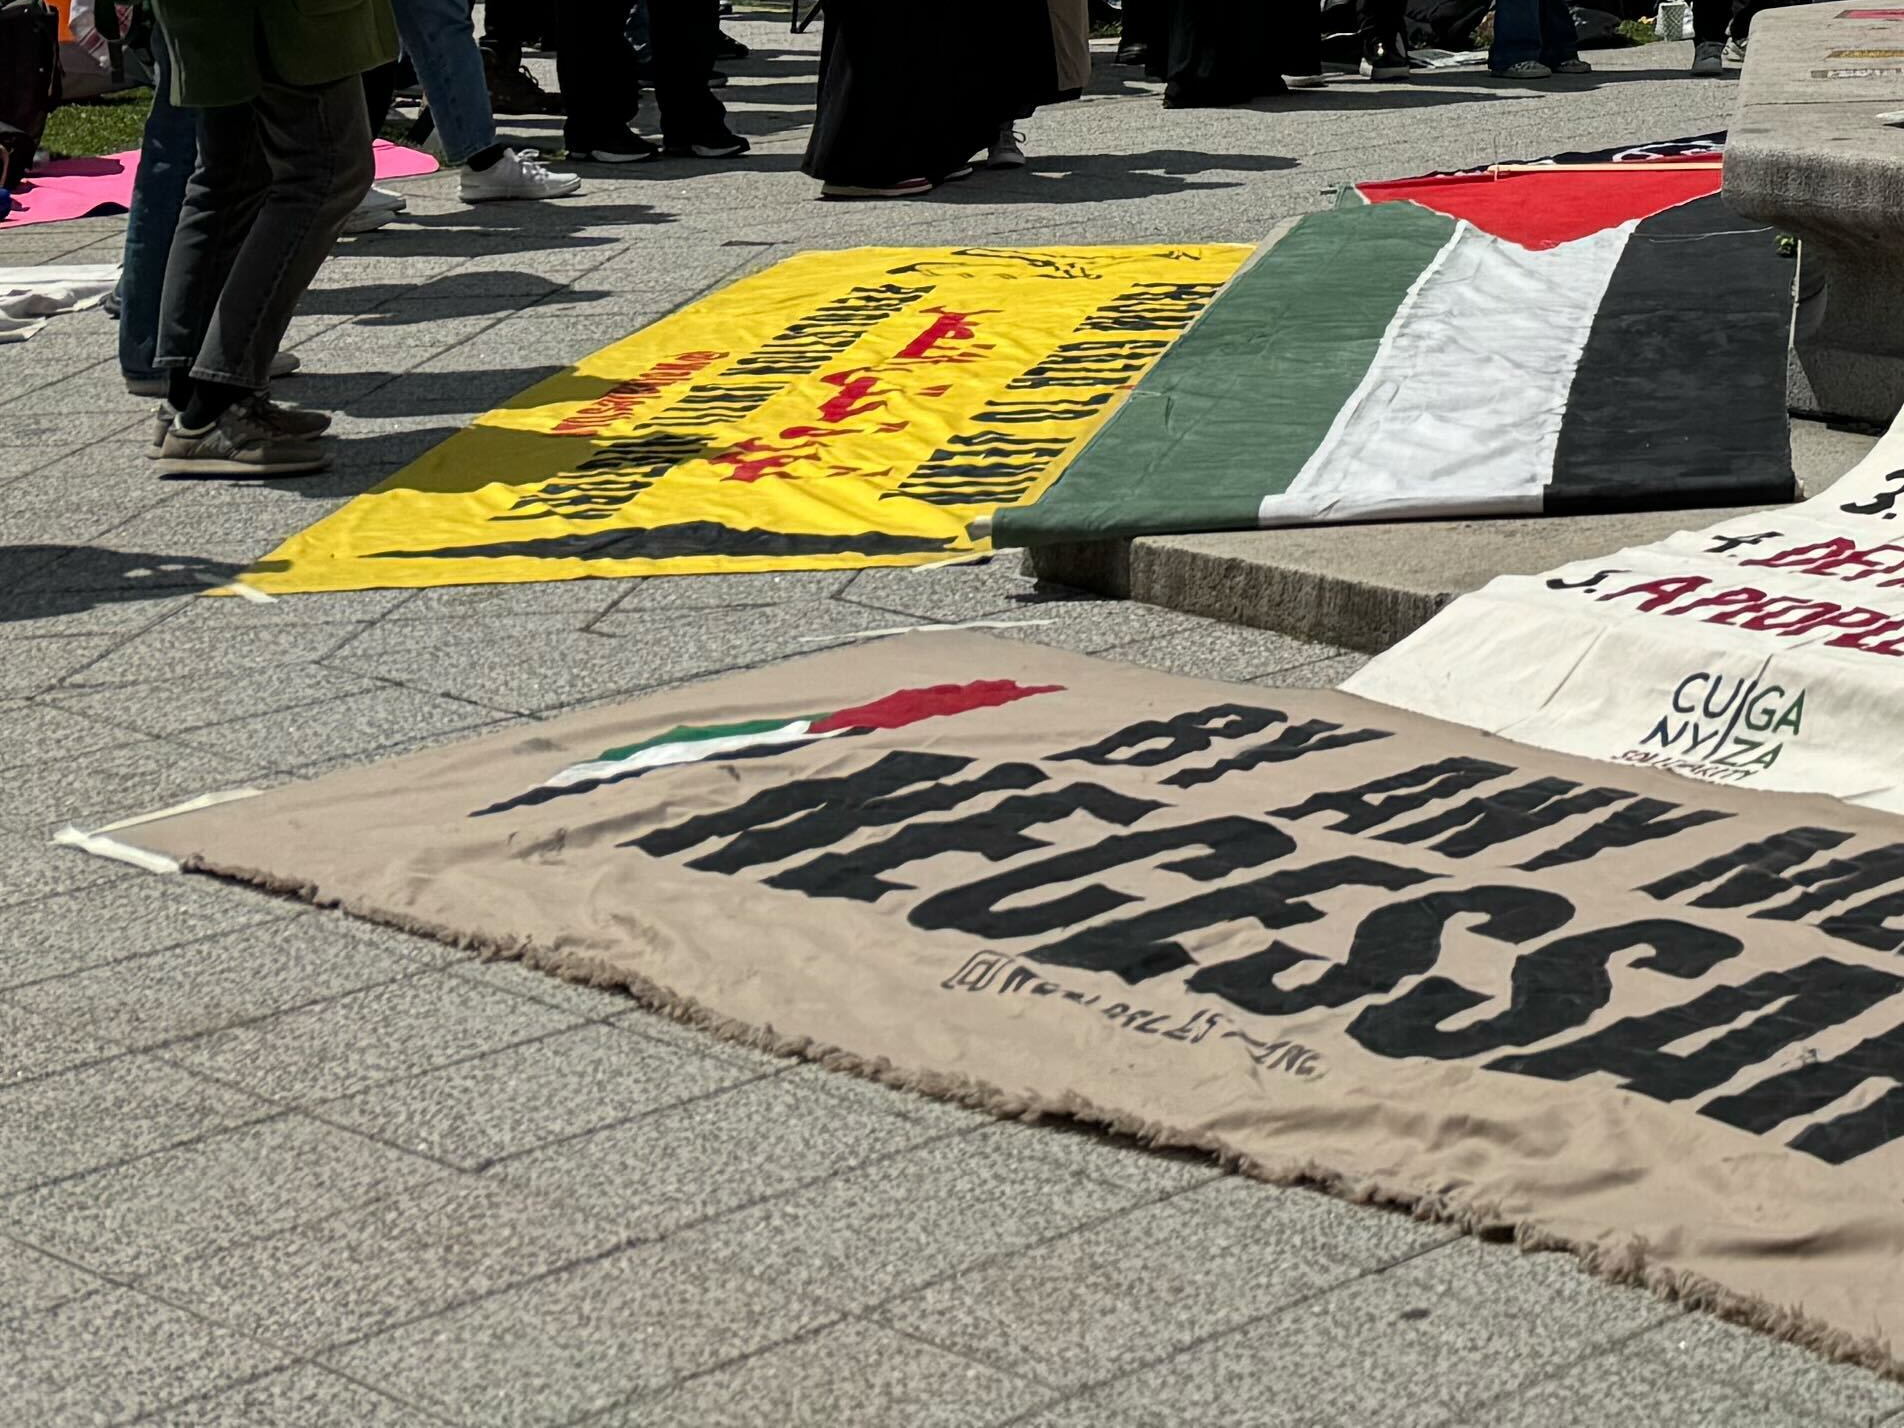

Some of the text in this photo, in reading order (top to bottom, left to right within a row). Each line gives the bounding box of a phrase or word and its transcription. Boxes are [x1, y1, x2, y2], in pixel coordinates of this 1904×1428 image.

[1840, 468, 1900, 522] 3.
[1599, 573, 1712, 617] A
[1671, 670, 1808, 737] CU GA
[1610, 747, 1760, 785] SOLIDARITY
[1641, 718, 1785, 772] NY ZA
[1047, 703, 1394, 788] BY
[1269, 752, 1737, 871] ANY
